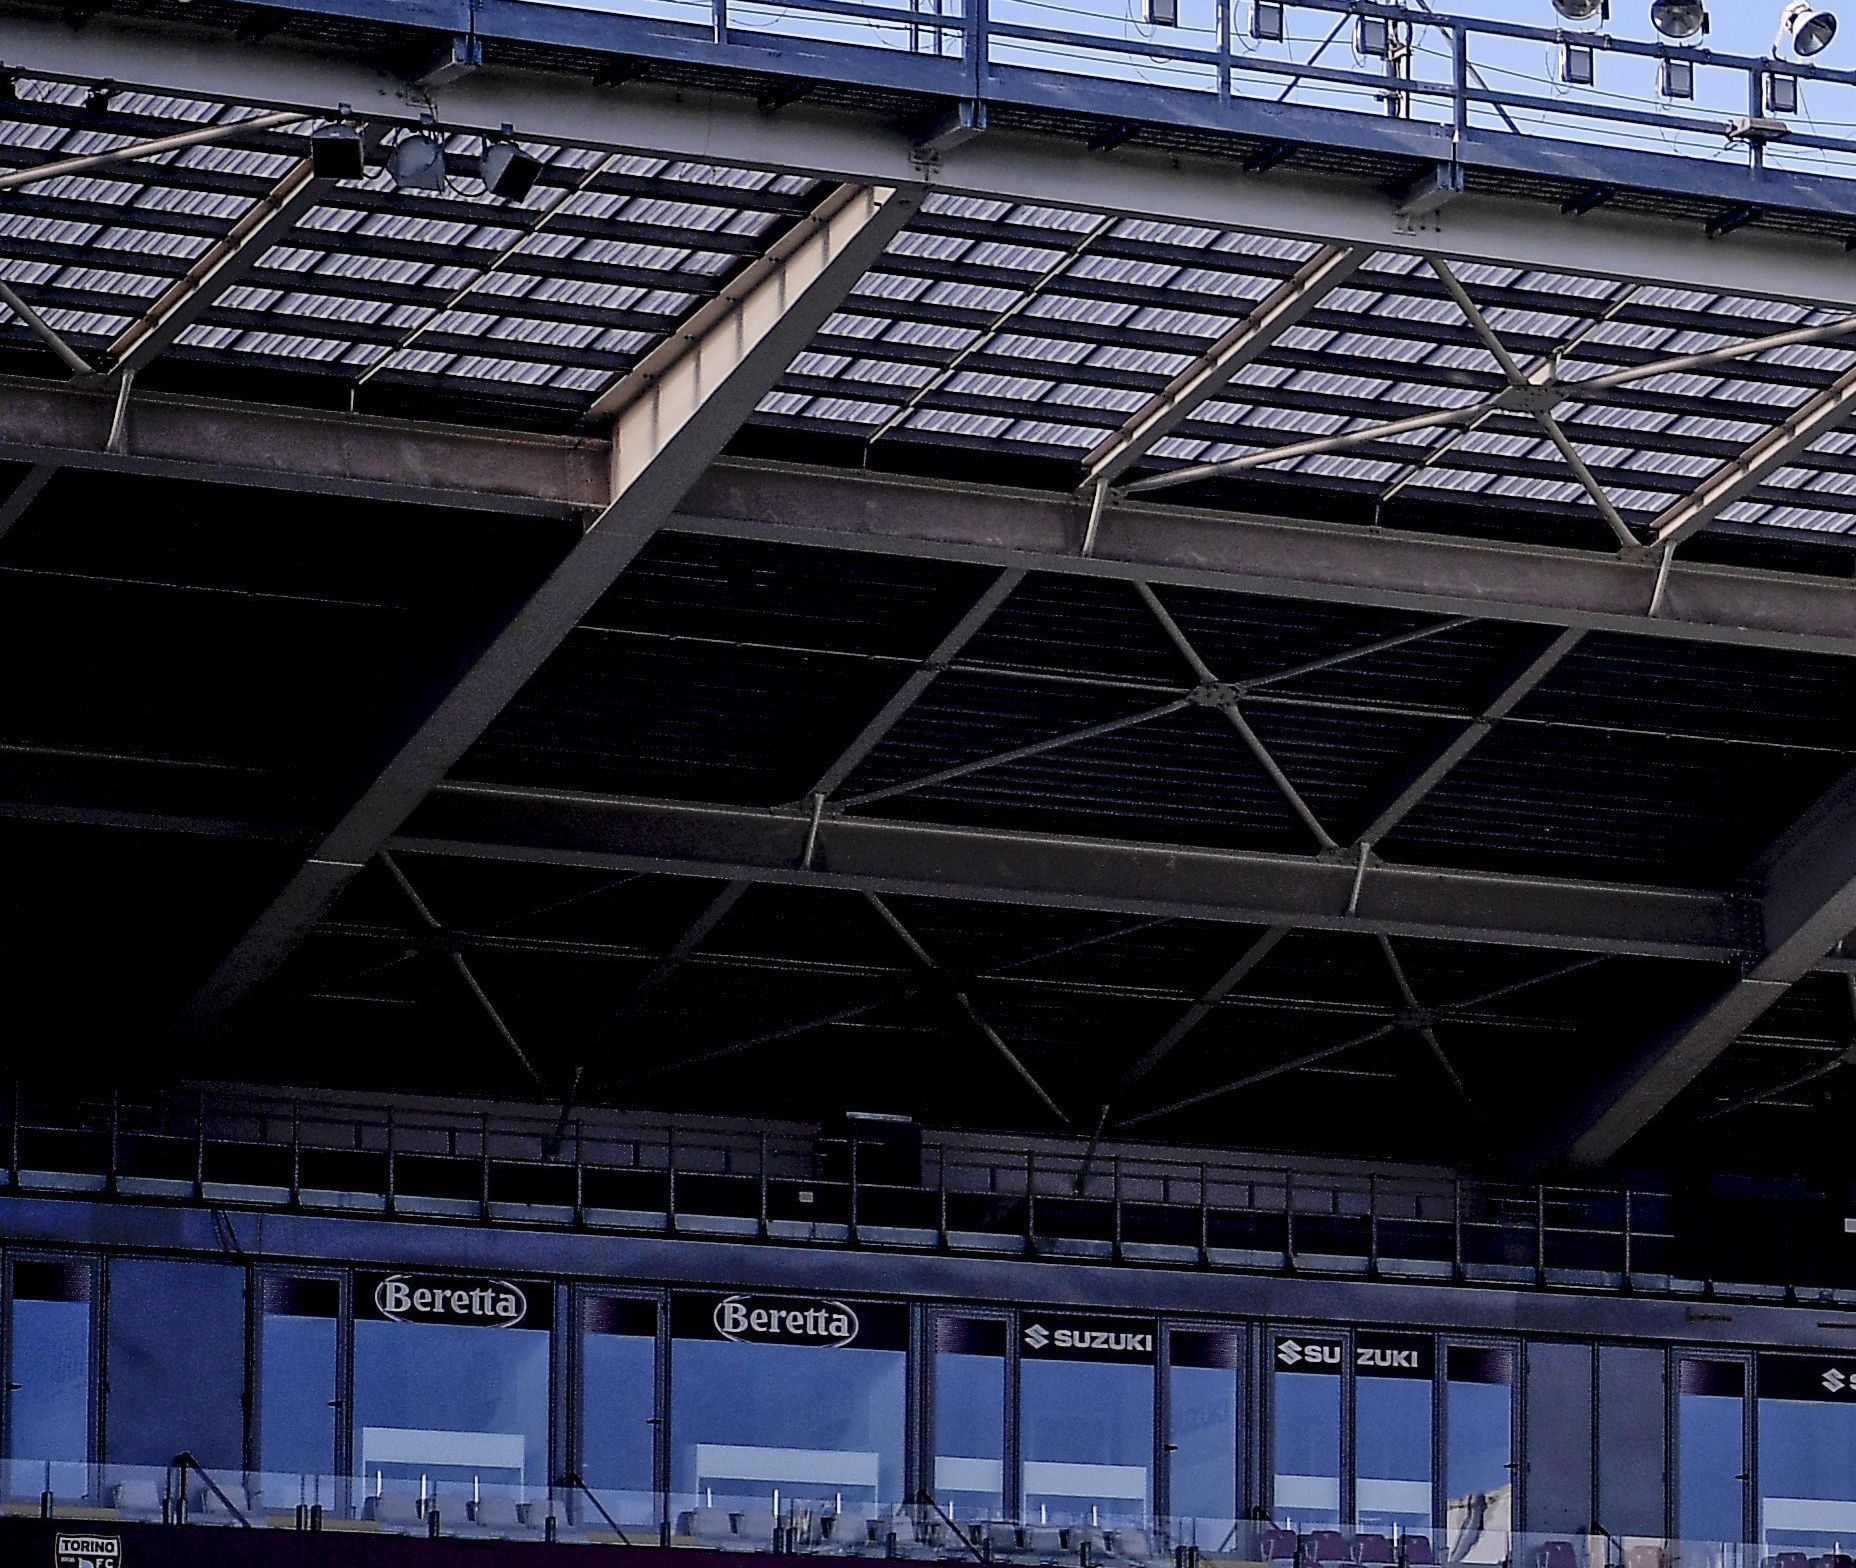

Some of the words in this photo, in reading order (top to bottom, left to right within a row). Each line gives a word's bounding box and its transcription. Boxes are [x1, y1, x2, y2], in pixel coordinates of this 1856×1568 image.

[385, 1282, 518, 1318] Beretta
[723, 1302, 850, 1337] Beretta
[1053, 1328, 1153, 1354] SUZUKI
[62, 1540, 115, 1554] TORINO
